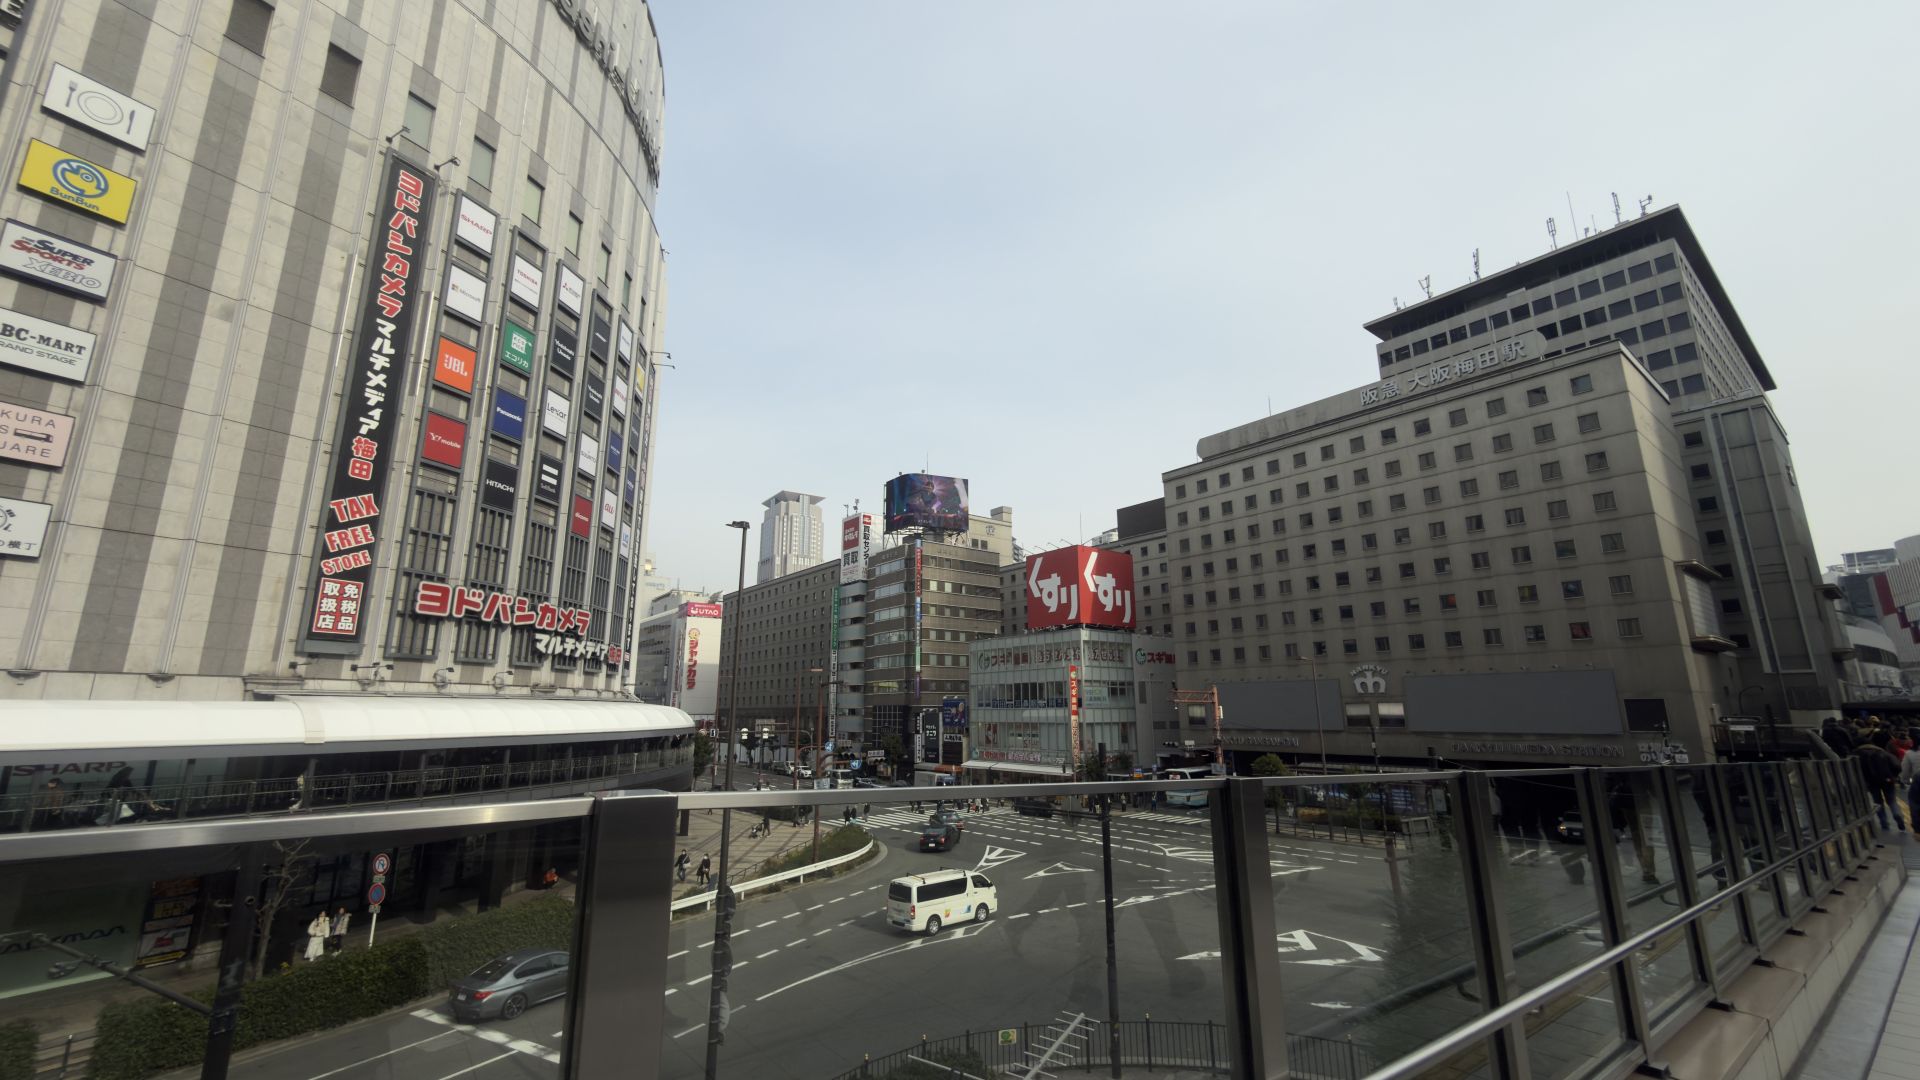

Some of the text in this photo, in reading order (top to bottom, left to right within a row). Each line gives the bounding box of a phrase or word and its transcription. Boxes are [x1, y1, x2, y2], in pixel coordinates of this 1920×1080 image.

[50, 186, 100, 212] BunBun
[461, 214, 493, 235] SHARP
[11, 240, 86, 270] SPORTS
[34, 240, 95, 266] SUPER
[22, 257, 102, 289] XEBIO
[36, 350, 77, 366] STAGE
[444, 353, 468, 377] JBL
[504, 351, 529, 368] エコリカ
[1360, 339, 1527, 407] 阪急 大阪梅田駅
[496, 406, 523, 422] Panasonic
[546, 402, 567, 420] Lexar
[486, 479, 514, 493] HITACHI
[329, 493, 379, 523] TAX
[324, 524, 375, 552] FREE
[320, 550, 372, 576] STORE
[1028, 556, 1079, 620] くすり
[1083, 551, 1132, 624] くすり
[416, 580, 591, 635] ヨドバシカメラ
[12, 761, 127, 776] SHARP
